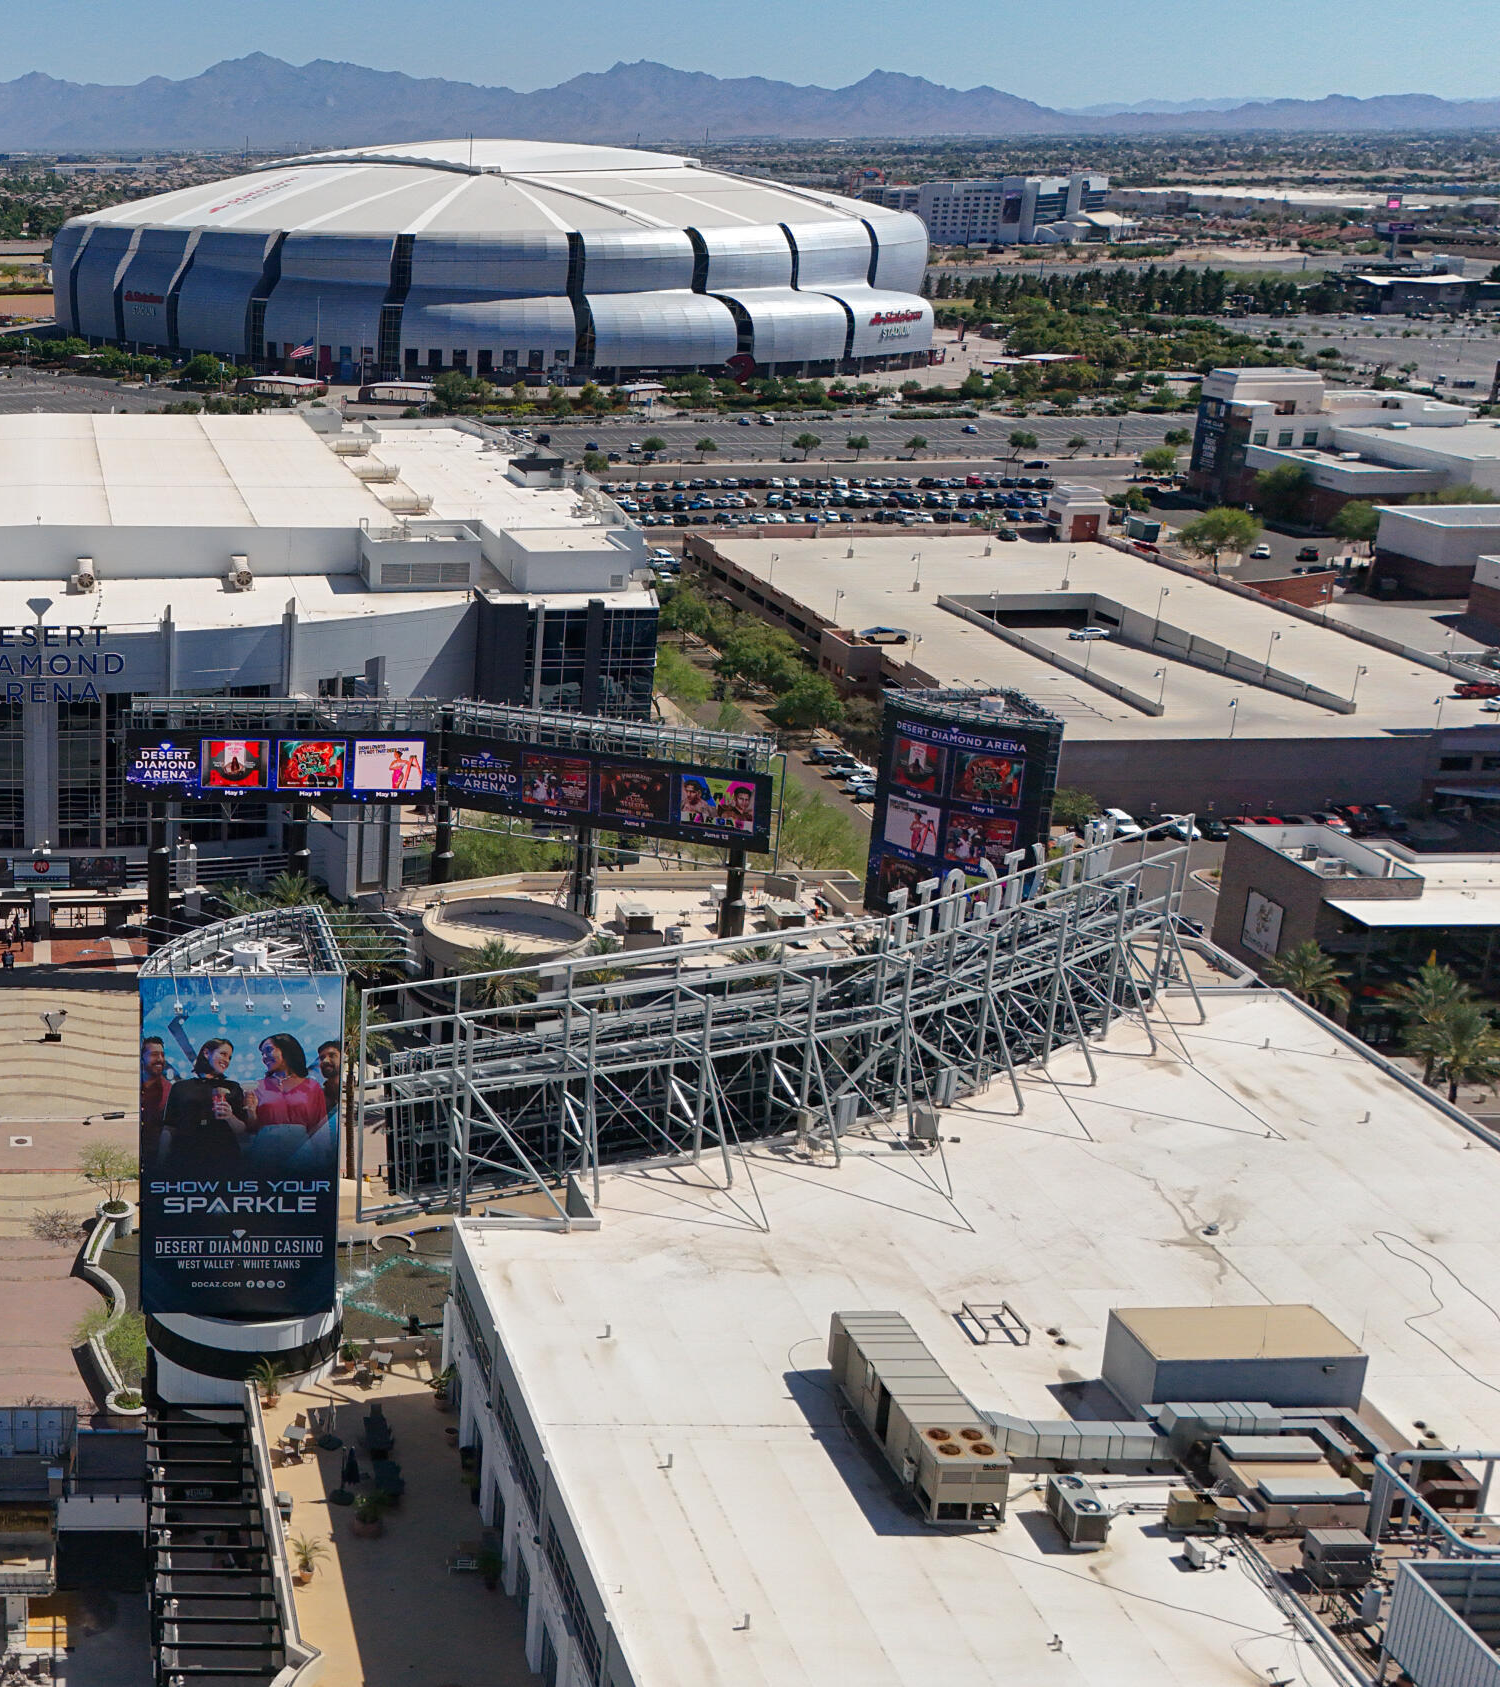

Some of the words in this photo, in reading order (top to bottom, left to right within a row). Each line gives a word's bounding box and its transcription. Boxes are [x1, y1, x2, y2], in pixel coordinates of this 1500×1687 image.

[896, 720, 930, 738] DESERT
[932, 730, 983, 748] DIAMOND
[986, 740, 1027, 754] ARENA
[141, 750, 190, 760] DESERT
[135, 760, 196, 770] DIAMOND
[461, 758, 512, 769] DESERT
[144, 770, 188, 780] ARENA
[455, 768, 517, 783] DIAMOND
[464, 779, 508, 792] ARENA
[544, 808, 557, 816] May
[972, 805, 985, 814] May
[623, 820, 640, 828] June
[150, 1180, 220, 1193] SHOW
[227, 1180, 259, 1193] US
[266, 1180, 331, 1193] YOUR
[163, 1196, 317, 1214] SPARKLE
[155, 1240, 205, 1254] DESERT
[209, 1240, 270, 1254] DIAMOND
[274, 1240, 324, 1254] CASINO
[177, 1259, 202, 1270] WEST
[202, 1259, 234, 1270] VALLEY
[242, 1259, 270, 1270] WHITE
[272, 1259, 300, 1270] TANKS
[191, 1280, 242, 1289] DDCAZ.COM
